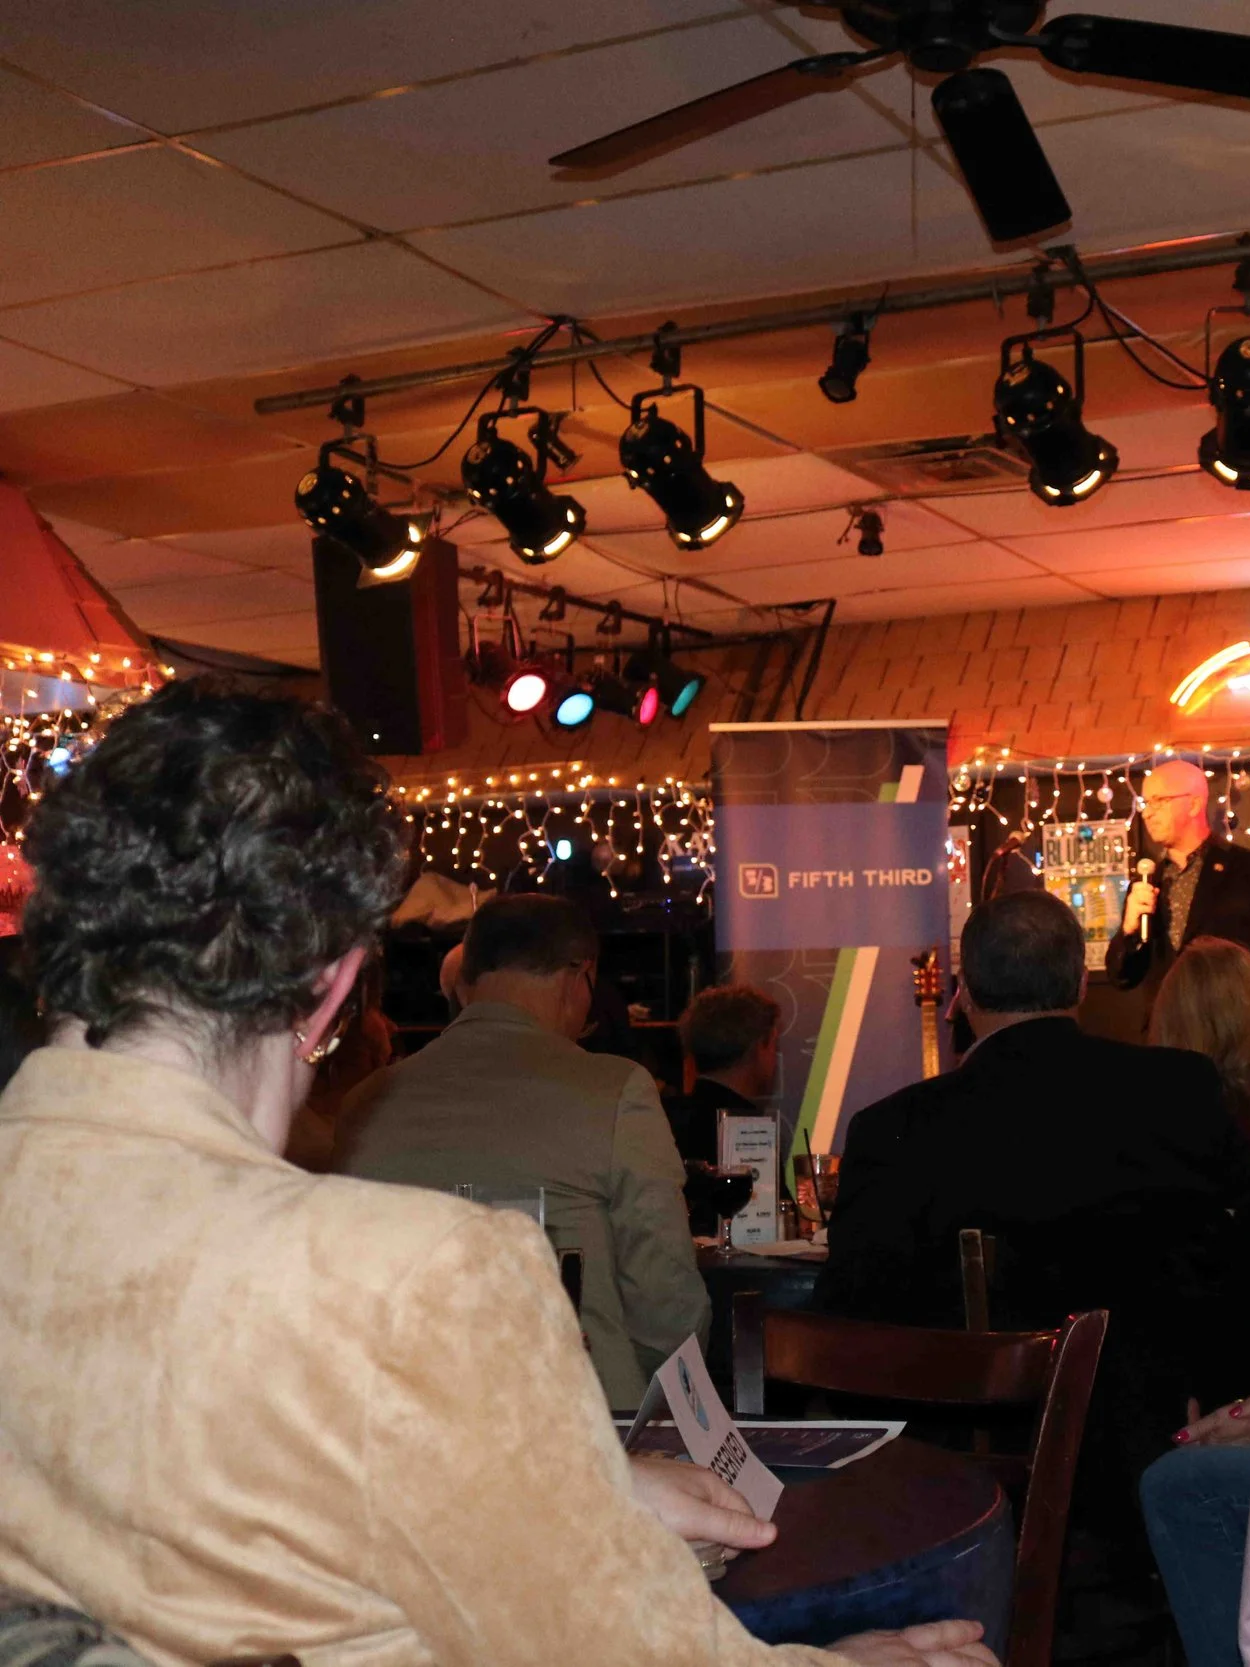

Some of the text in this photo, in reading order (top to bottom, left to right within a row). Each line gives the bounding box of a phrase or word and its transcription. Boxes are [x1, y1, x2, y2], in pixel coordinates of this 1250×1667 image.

[1046, 835, 1124, 866] BLUEBIRD
[788, 871, 854, 889] FIFTH
[862, 868, 933, 886] THIRD
[708, 1431, 747, 1486] ESERVED
